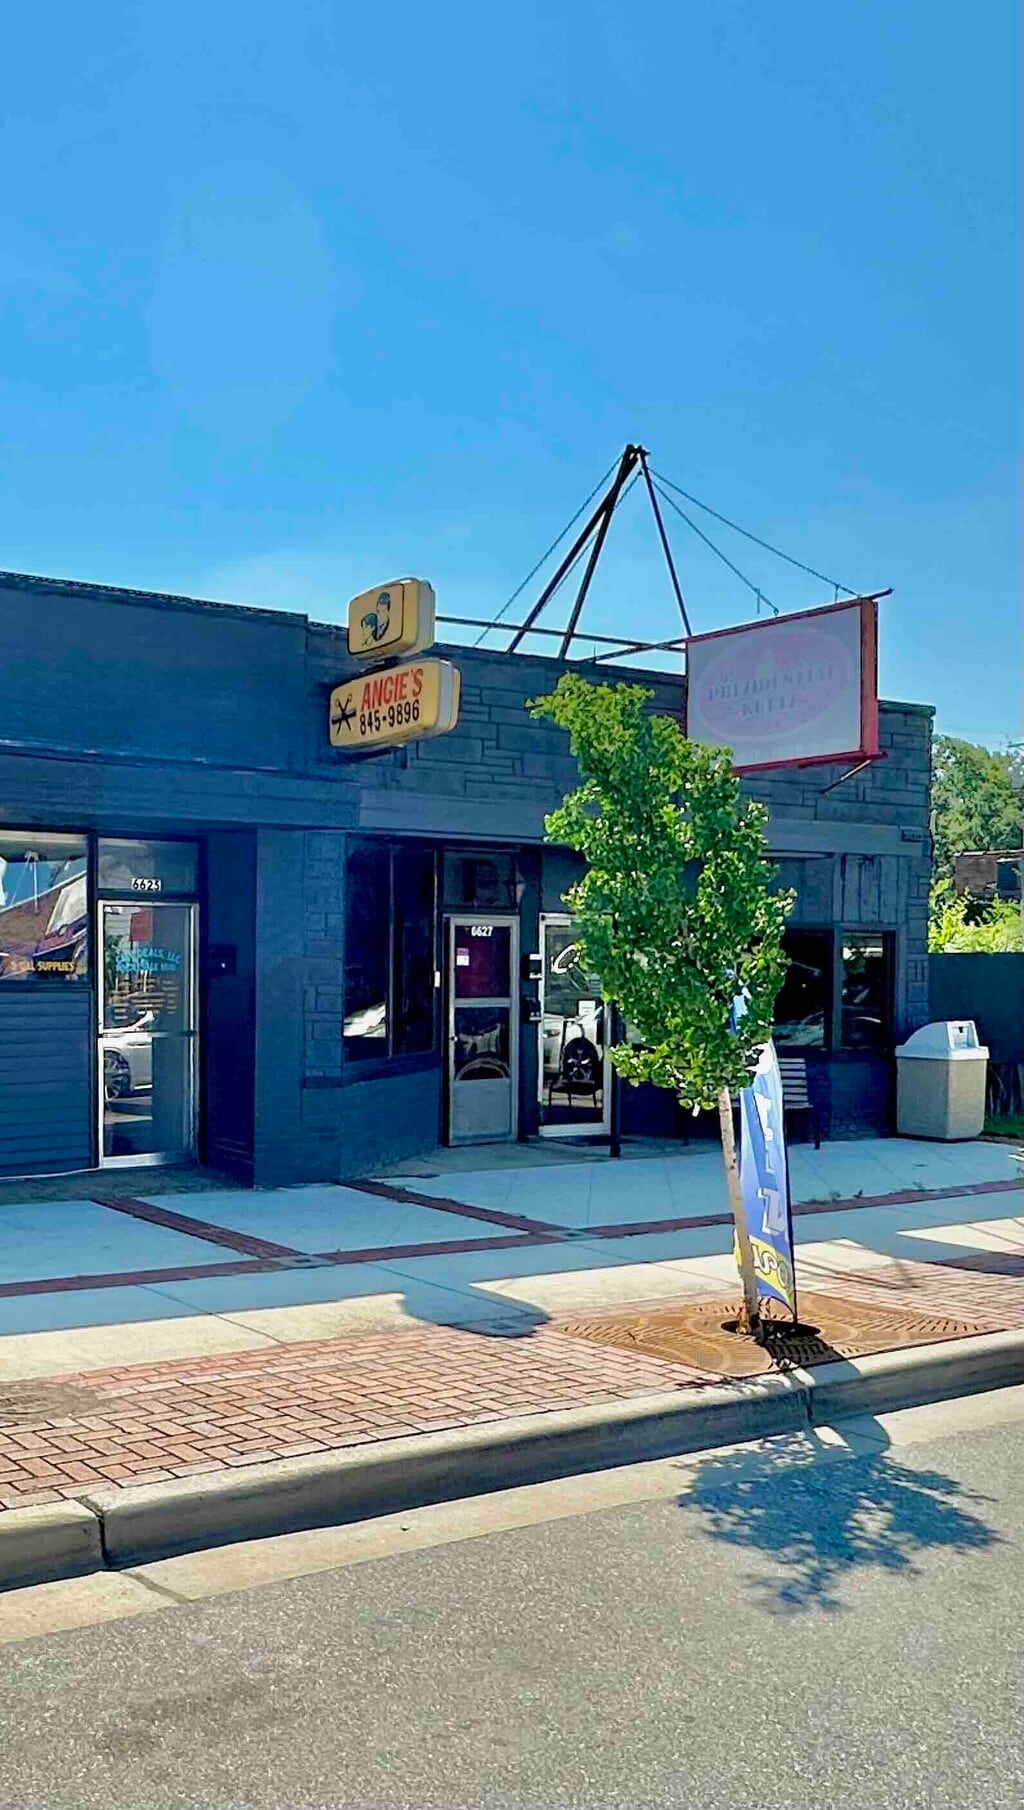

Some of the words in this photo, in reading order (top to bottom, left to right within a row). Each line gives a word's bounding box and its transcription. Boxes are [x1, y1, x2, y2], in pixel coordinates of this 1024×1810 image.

[360, 668, 424, 712] ANGIE'S
[359, 699, 420, 735] 845-9896
[132, 879, 160, 891] 6625
[471, 926, 493, 937] 6627
[37, 960, 75, 972] SUPPLIES
